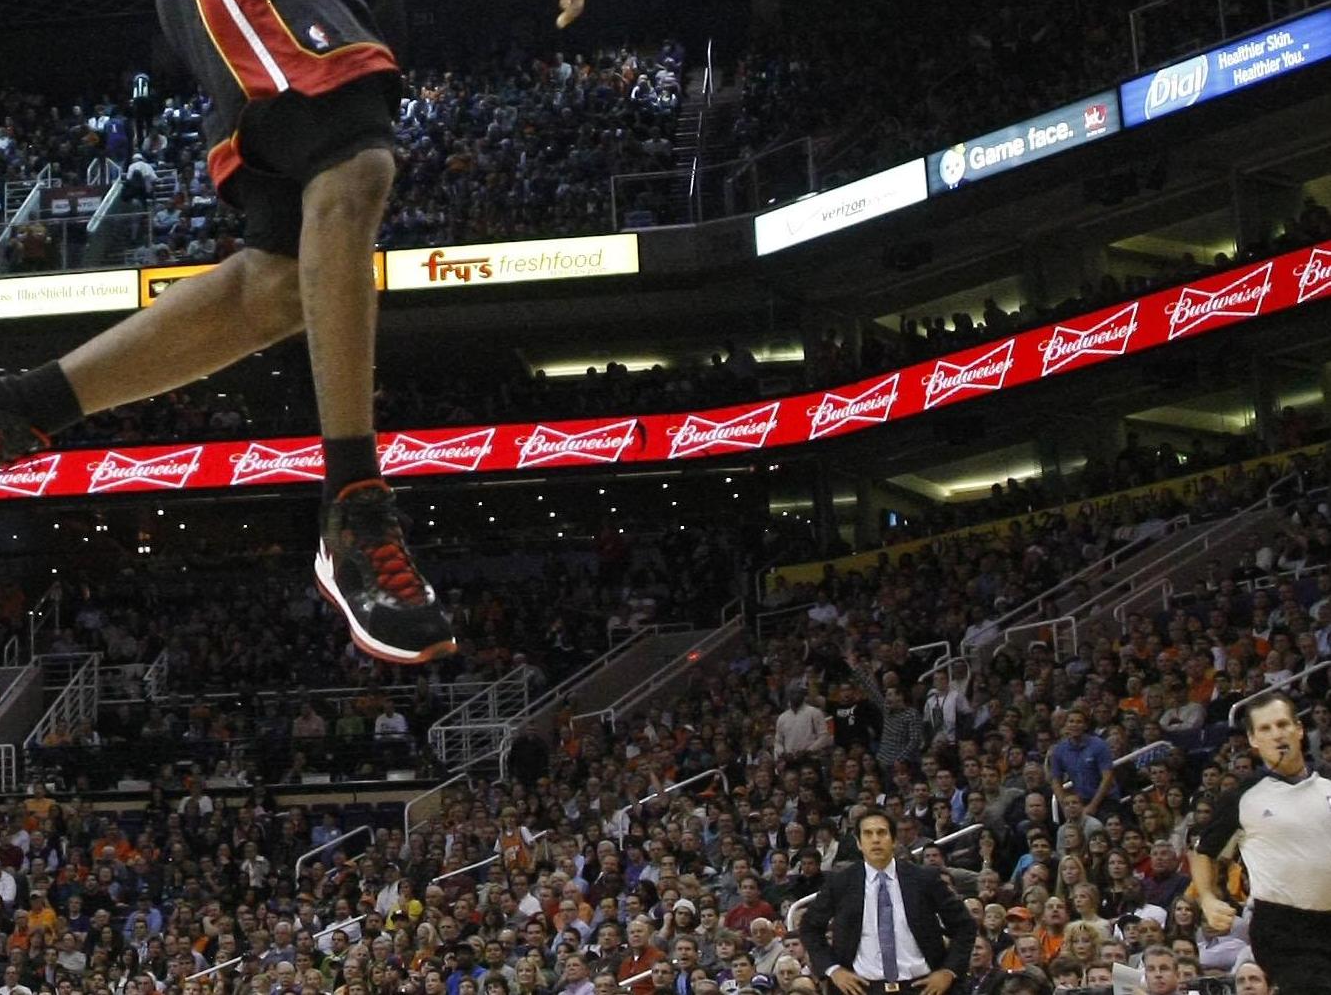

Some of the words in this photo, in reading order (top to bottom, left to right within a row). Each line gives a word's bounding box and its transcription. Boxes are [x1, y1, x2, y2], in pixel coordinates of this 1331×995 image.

[1219, 41, 1265, 70] Healthier
[1150, 65, 1203, 108] Dial
[1233, 59, 1281, 86] Healthier
[970, 137, 1025, 170] Game
[1027, 120, 1074, 151] face.
[1165, 284, 1272, 324] Budweiser
[1039, 323, 1138, 362] Budweiser
[922, 357, 1014, 393] Budweiser
[807, 391, 898, 425] Budweiser
[516, 430, 633, 454] Budweiser
[668, 418, 778, 446] Budweiser
[230, 450, 324, 473] Budweis
[377, 439, 492, 465] Budweiser
[87, 457, 199, 482] Budweiser
